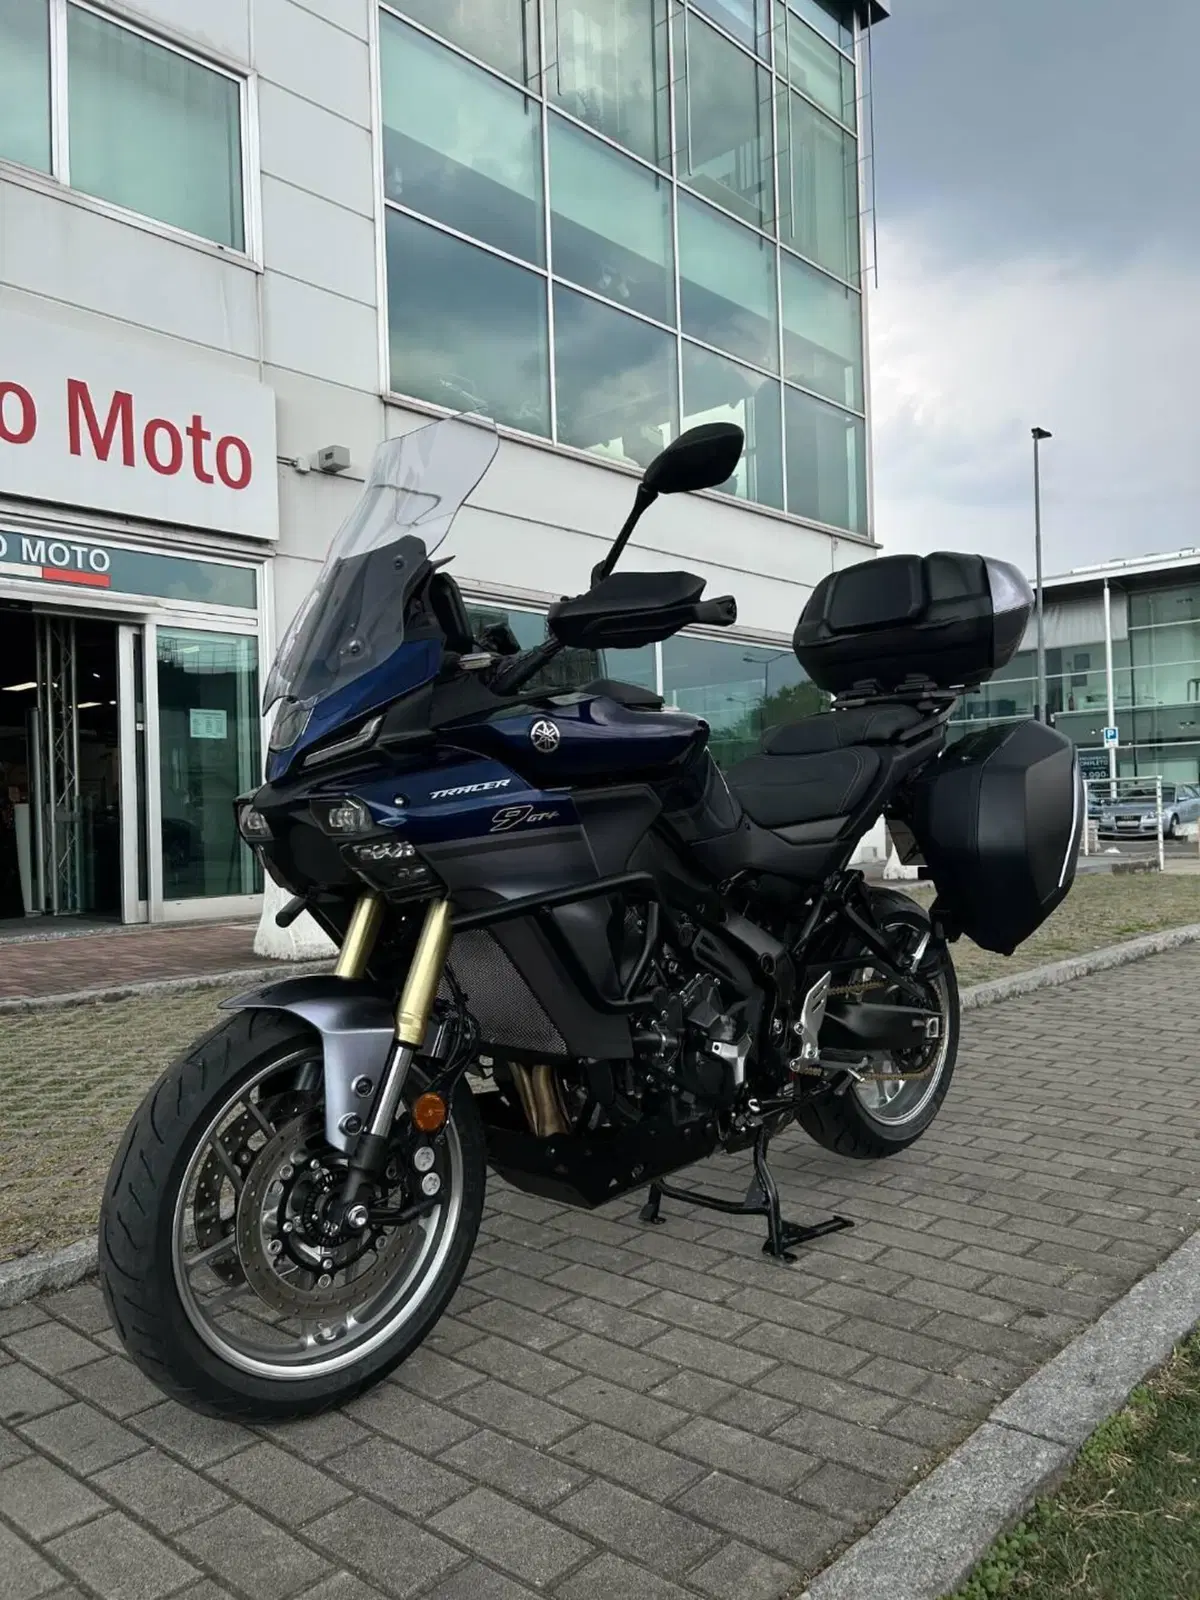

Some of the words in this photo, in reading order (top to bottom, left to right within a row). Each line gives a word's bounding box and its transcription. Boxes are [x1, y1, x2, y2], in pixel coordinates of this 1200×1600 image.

[67, 378, 253, 490] Moto
[21, 538, 110, 572] MOTO
[429, 778, 512, 799] TRACER
[489, 804, 534, 832] 9
